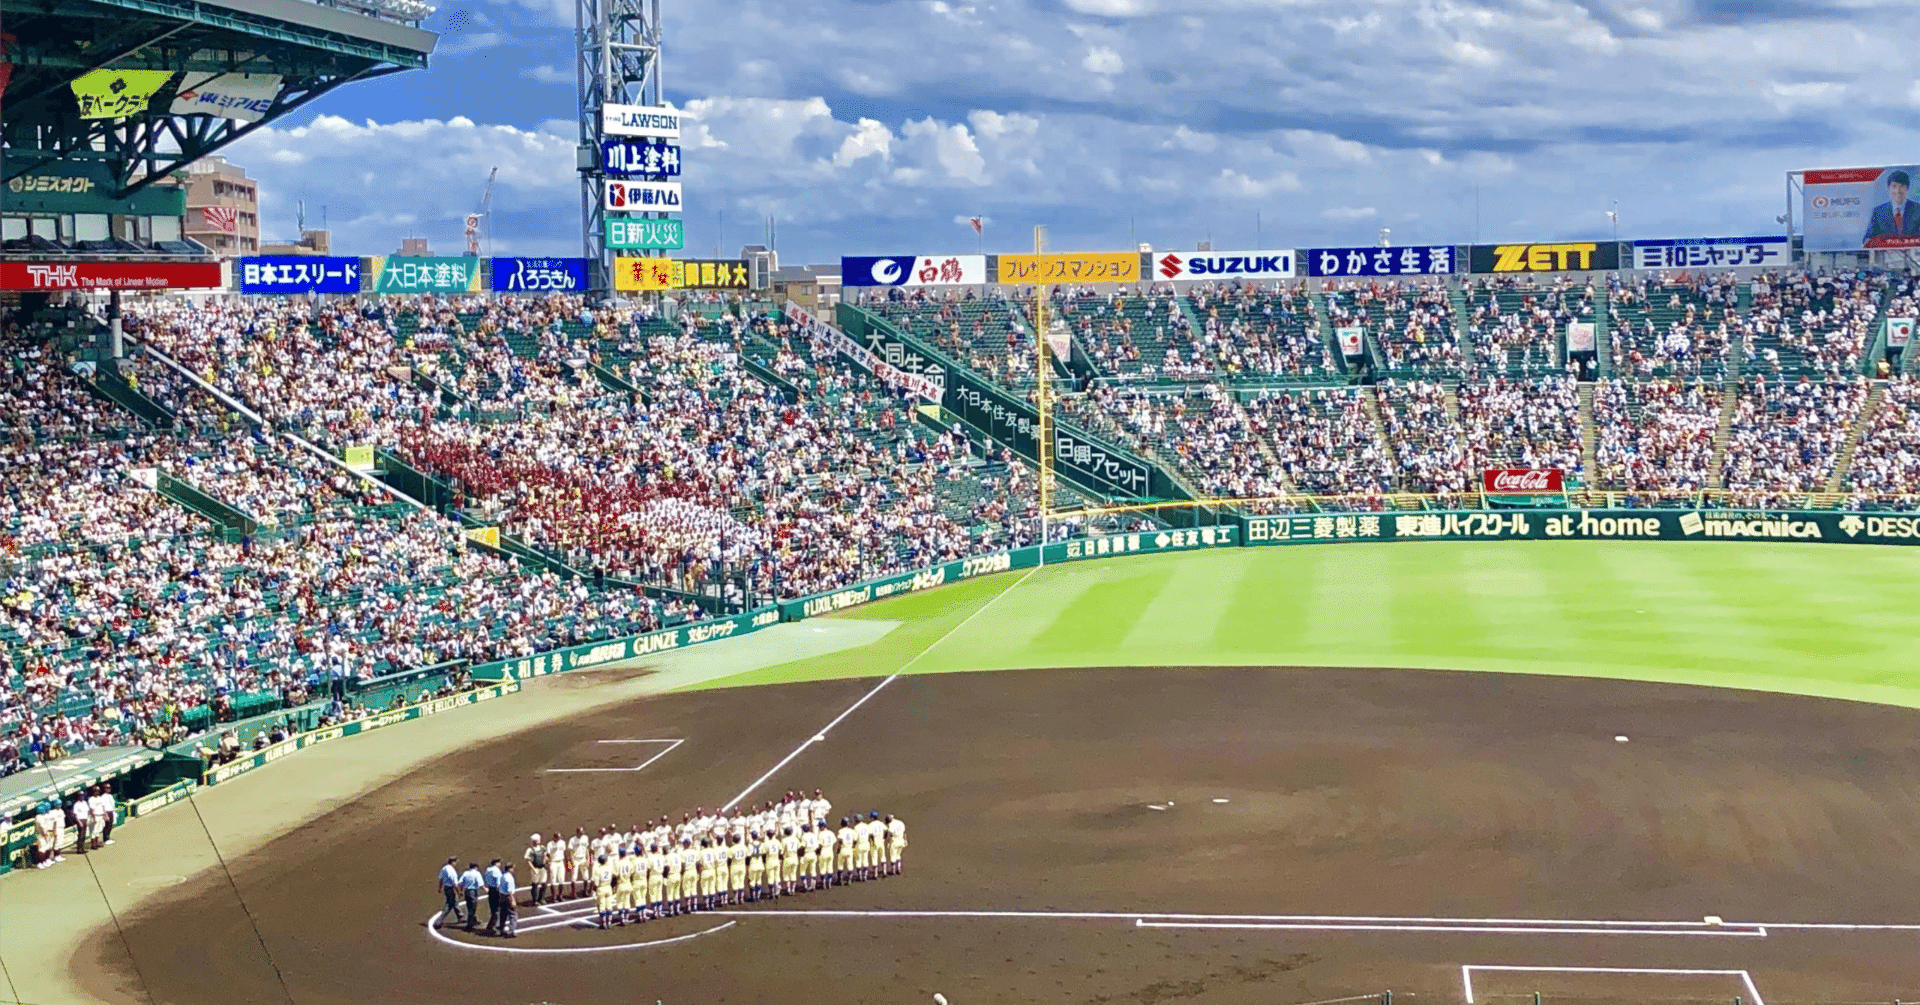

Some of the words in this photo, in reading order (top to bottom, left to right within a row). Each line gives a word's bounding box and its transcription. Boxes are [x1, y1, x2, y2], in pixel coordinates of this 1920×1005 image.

[621, 112, 678, 130] LAWSON
[608, 144, 680, 174] 川上塗料
[628, 188, 680, 206] 伊藤ハム
[611, 222, 678, 245] 日新火災
[918, 257, 964, 283] 白鶴
[1188, 255, 1290, 275] SUZUKI
[1320, 247, 1450, 275] わかさ生活
[1492, 243, 1597, 272] ZETT
[27, 265, 78, 287] THK
[81, 277, 94, 286] The
[96, 277, 113, 286] Mark
[115, 277, 122, 287] of
[124, 277, 144, 287] Linear
[244, 263, 358, 285] 日本エスリード
[386, 262, 468, 288] 大日本塗料
[526, 269, 576, 290] ろうきん
[865, 329, 945, 389] 大同生命
[1058, 438, 1146, 490] 日興アセット
[1248, 515, 1380, 541] 田辺三菱製薬
[1396, 514, 1529, 537] 東進ハイスクール
[1545, 515, 1574, 536] at
[1577, 511, 1661, 537] home
[632, 631, 680, 656] GUNZE
[501, 651, 564, 681] 大和証券
